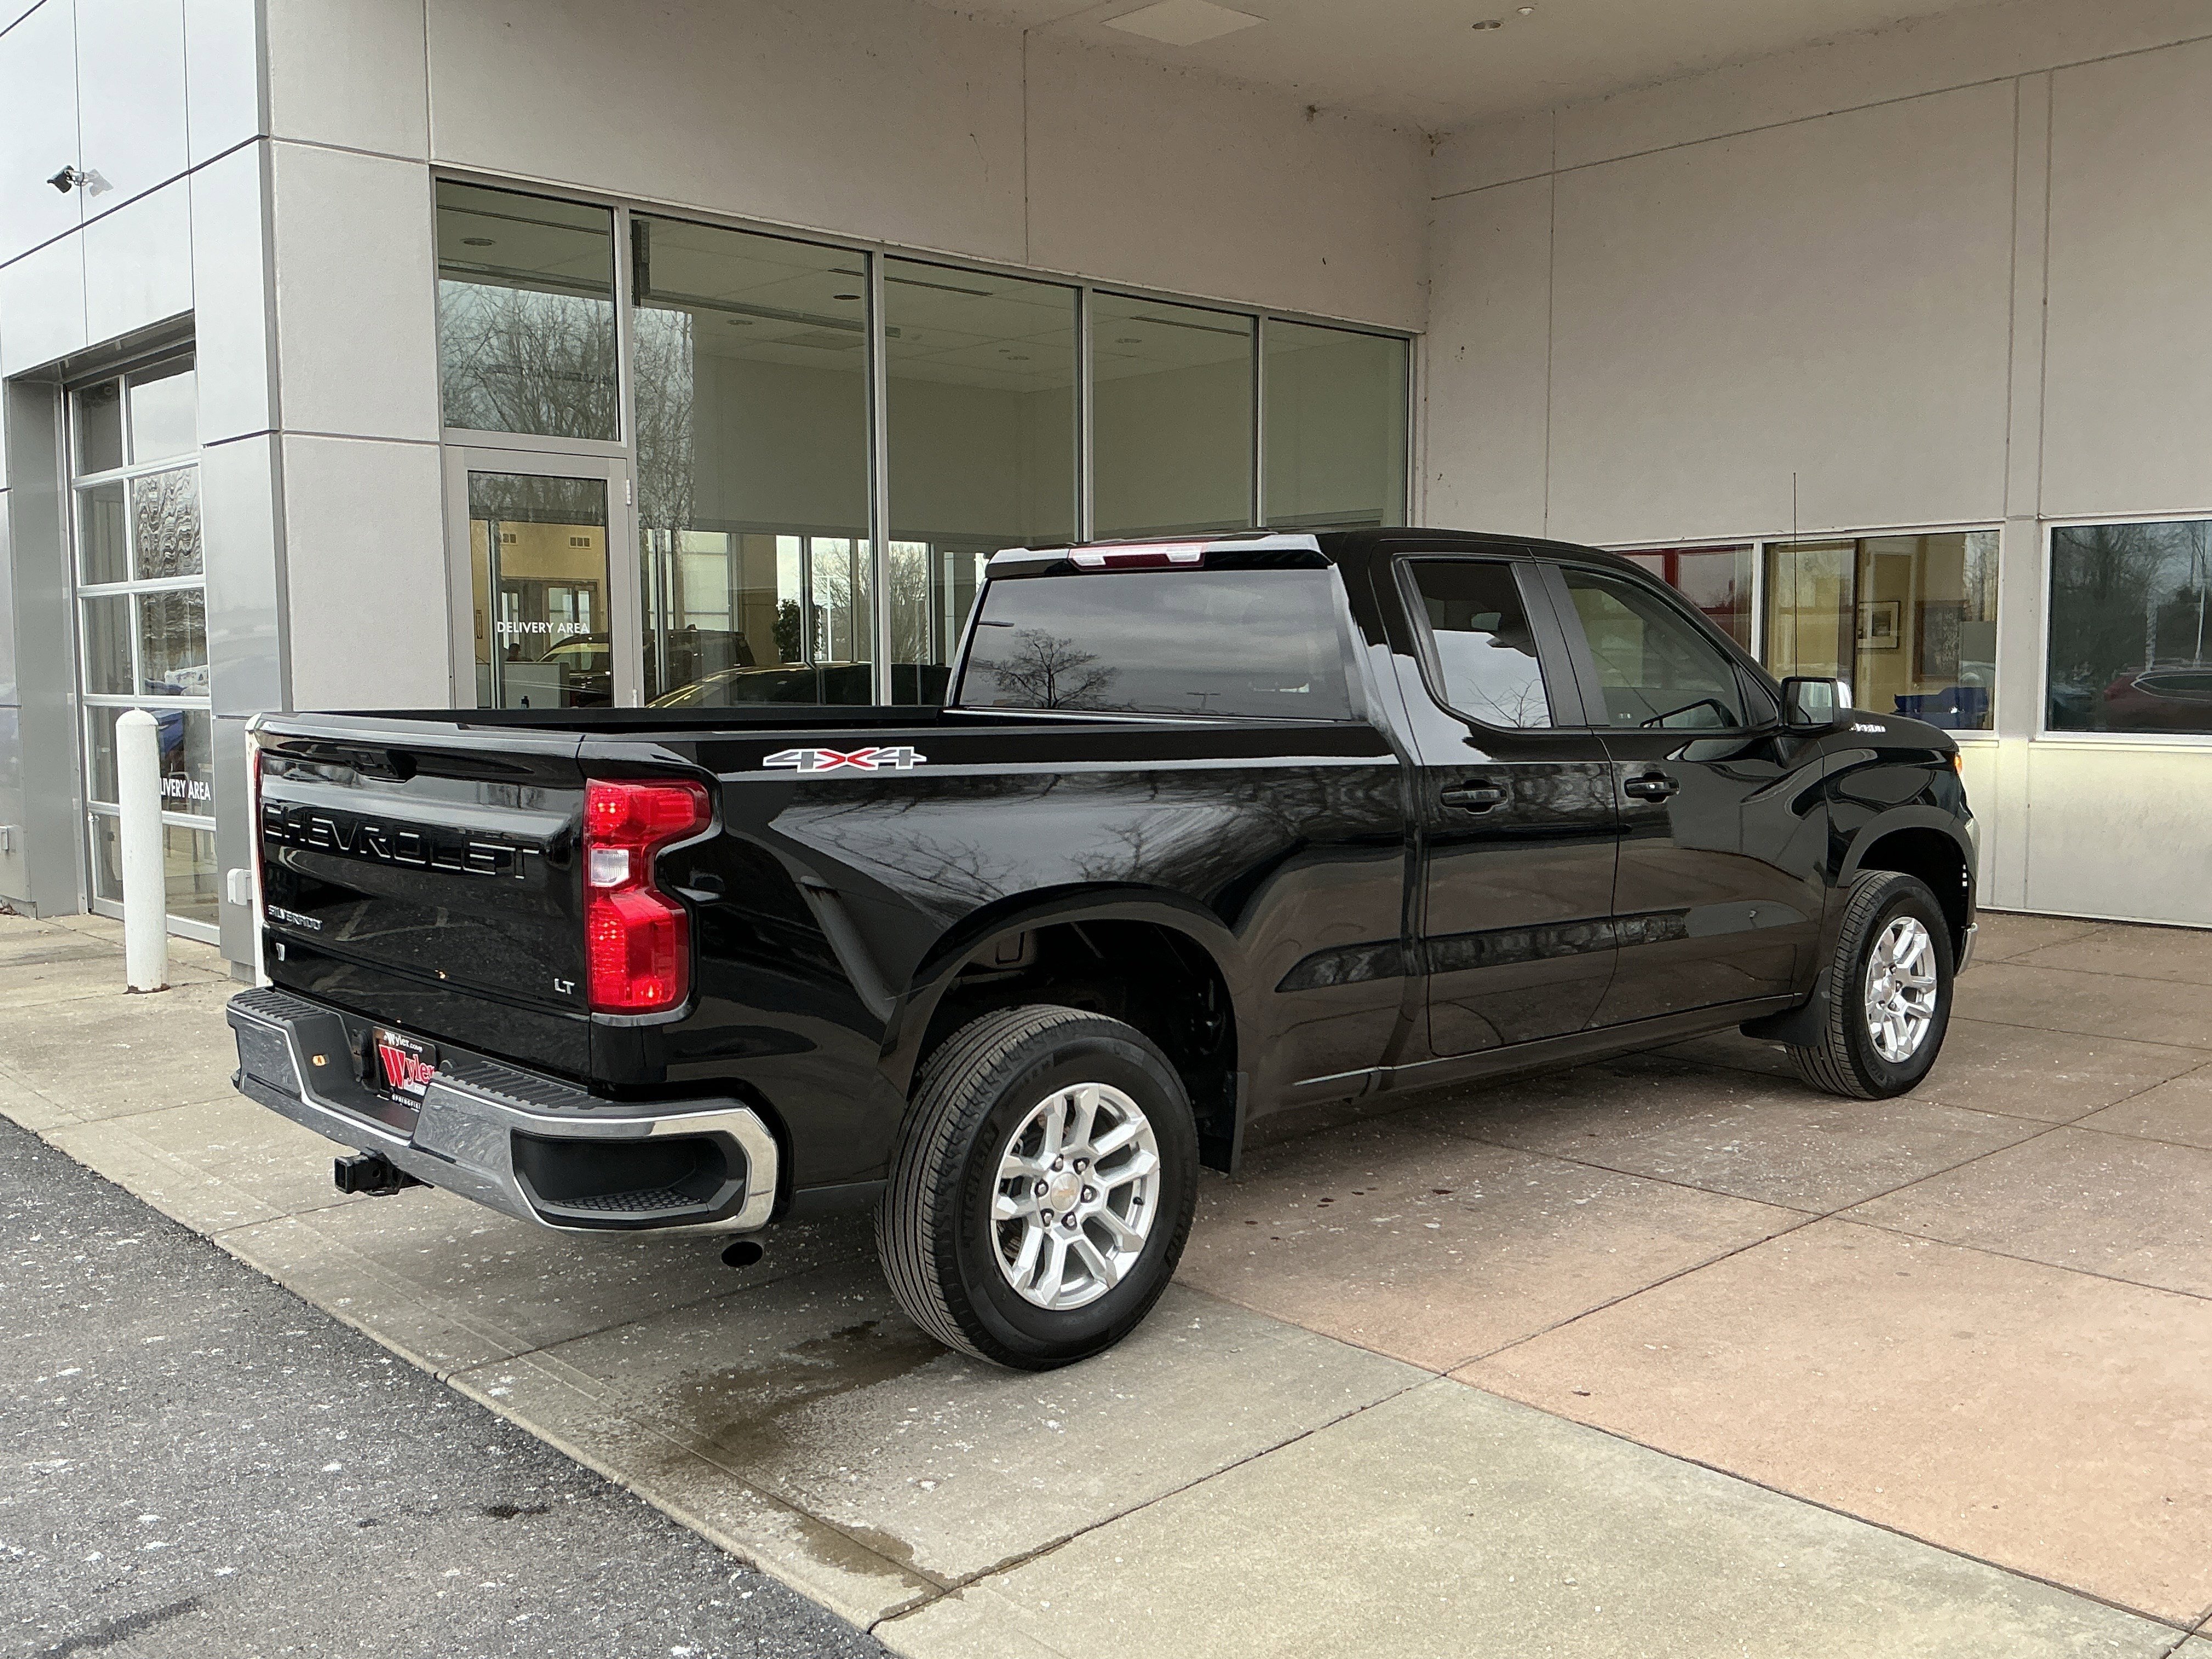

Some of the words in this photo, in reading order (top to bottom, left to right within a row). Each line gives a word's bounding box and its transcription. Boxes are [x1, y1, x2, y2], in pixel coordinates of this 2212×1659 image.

[497, 622, 554, 634] DELIVERY
[557, 623, 590, 634] AREA
[160, 777, 186, 798] LIVERY
[188, 780, 211, 800] AREA
[264, 804, 546, 880] CHEVROLET
[554, 978, 575, 994] LT
[379, 1044, 435, 1090] Wyler
